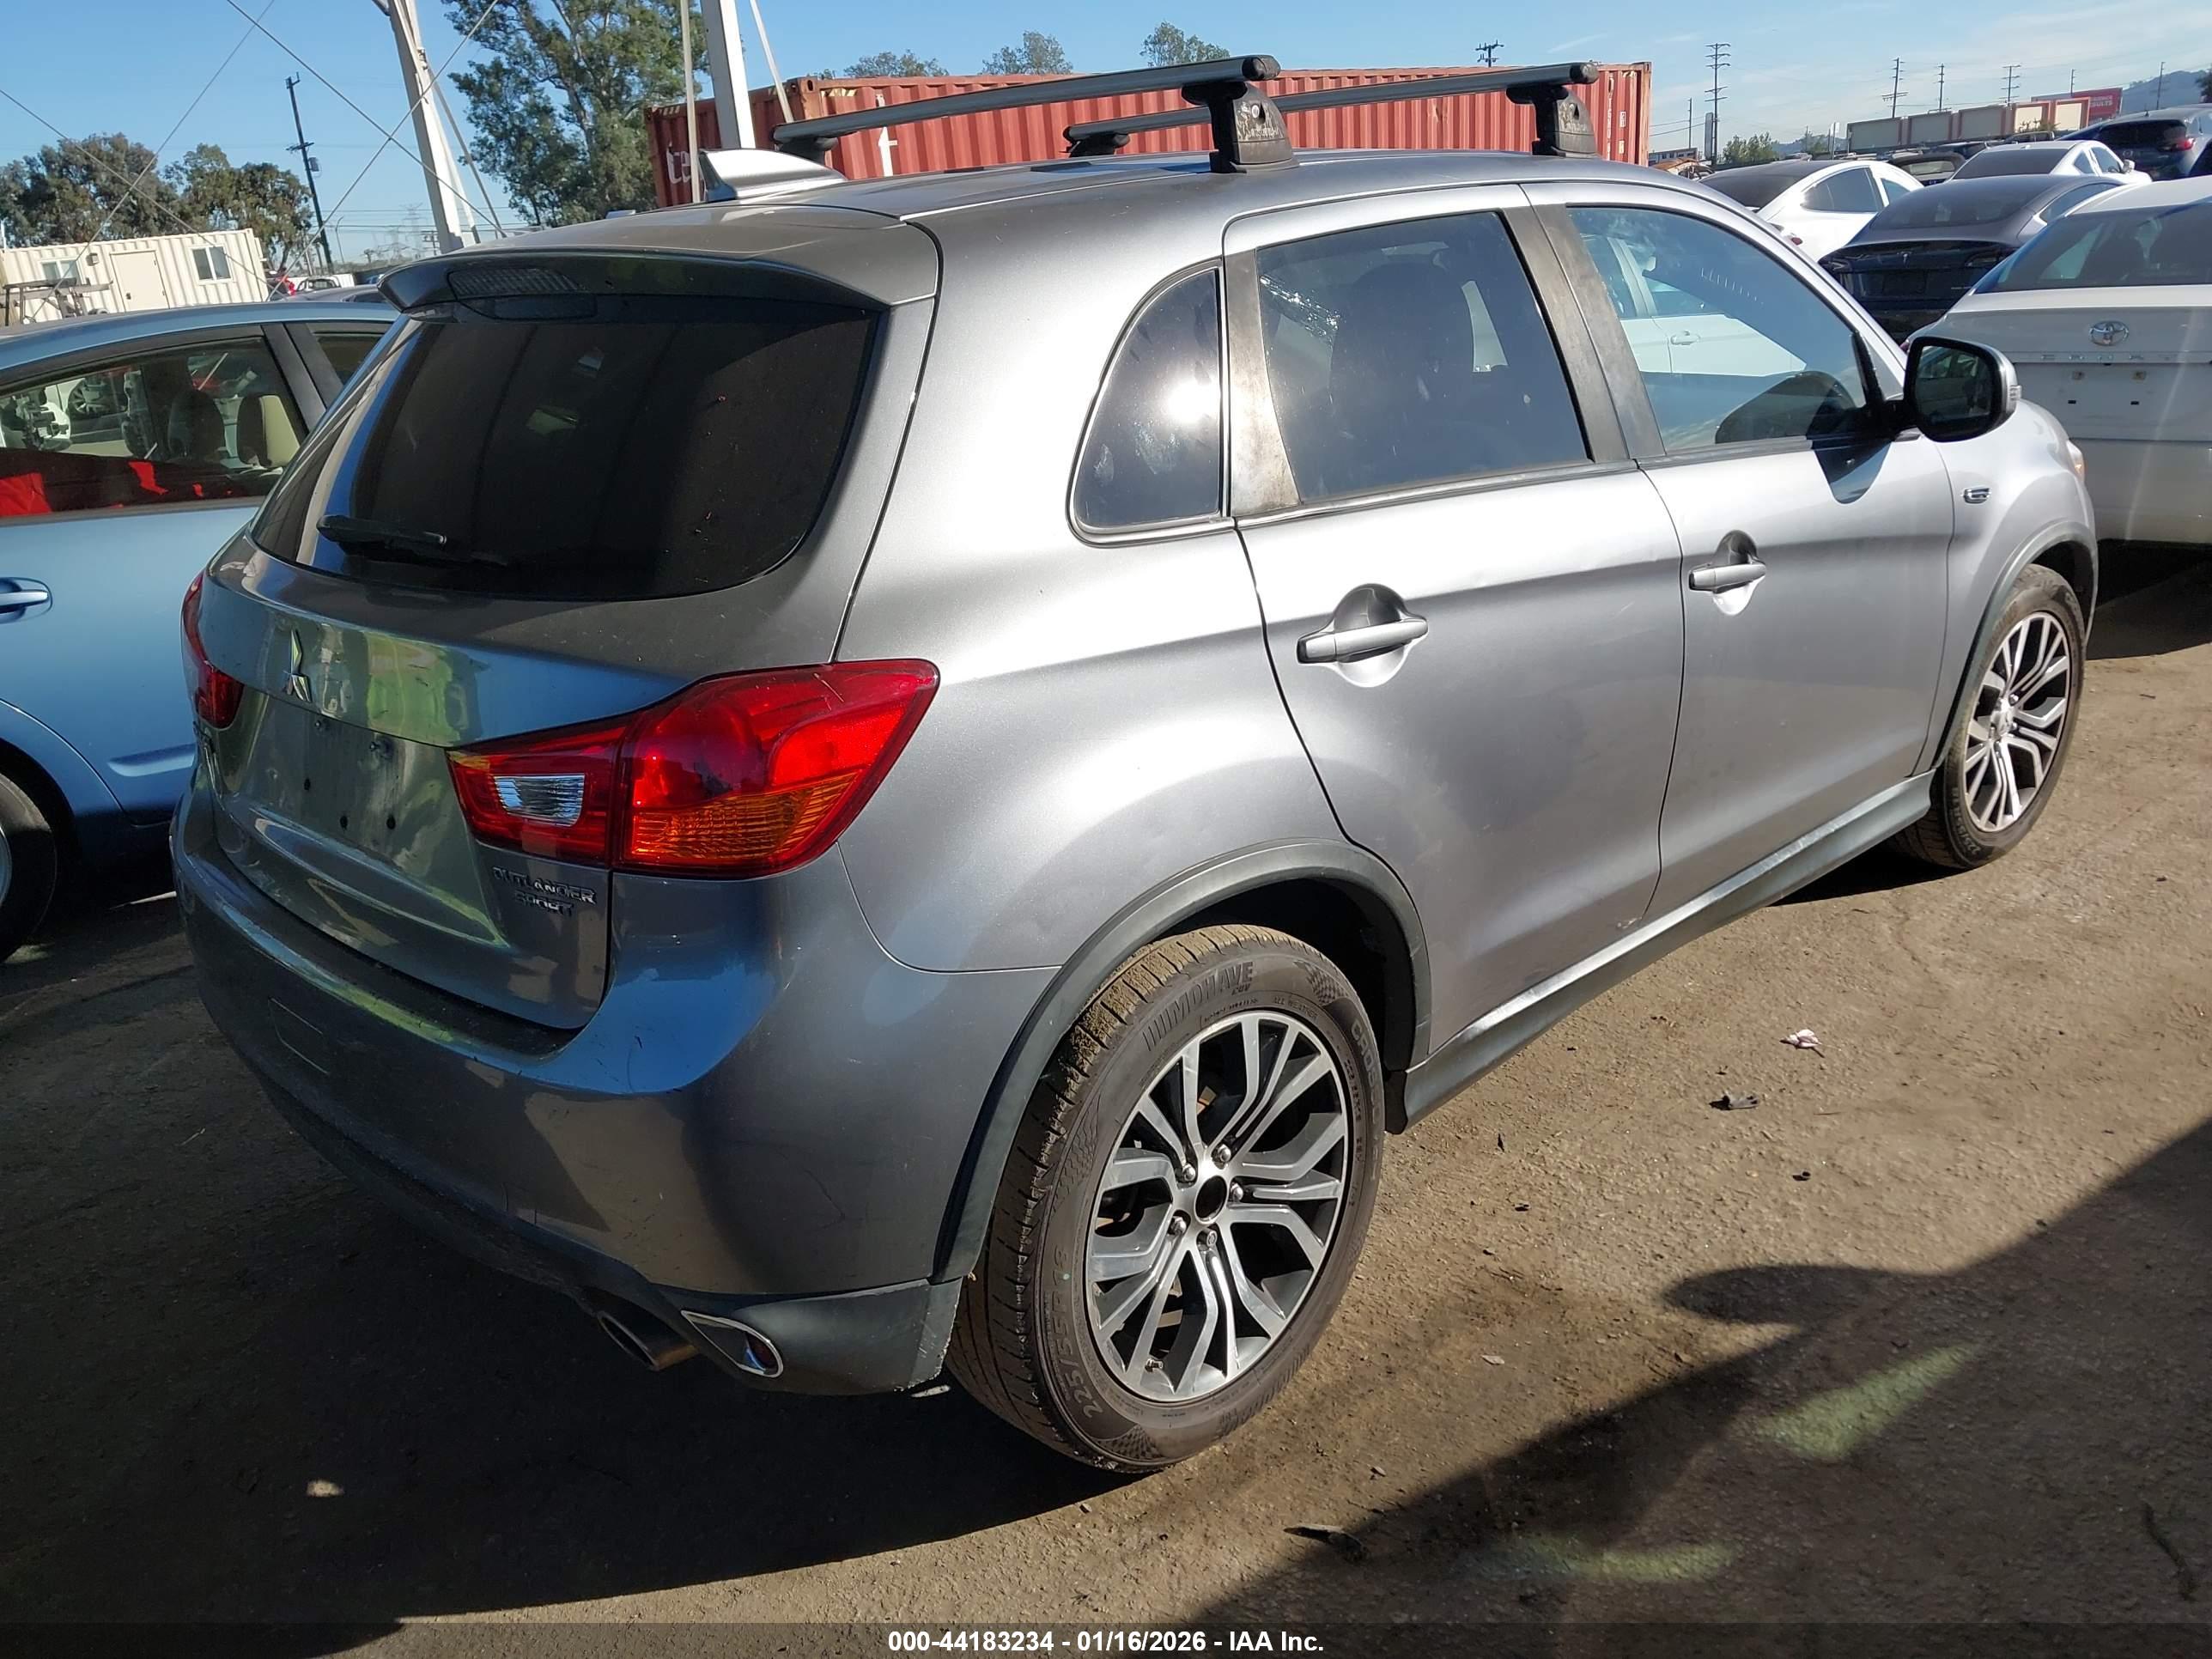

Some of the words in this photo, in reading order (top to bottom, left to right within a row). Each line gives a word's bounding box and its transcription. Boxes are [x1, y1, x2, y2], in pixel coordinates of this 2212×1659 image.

[666, 142, 691, 185] te
[492, 866, 598, 904] OUTLANDER
[515, 890, 575, 916] SPORT
